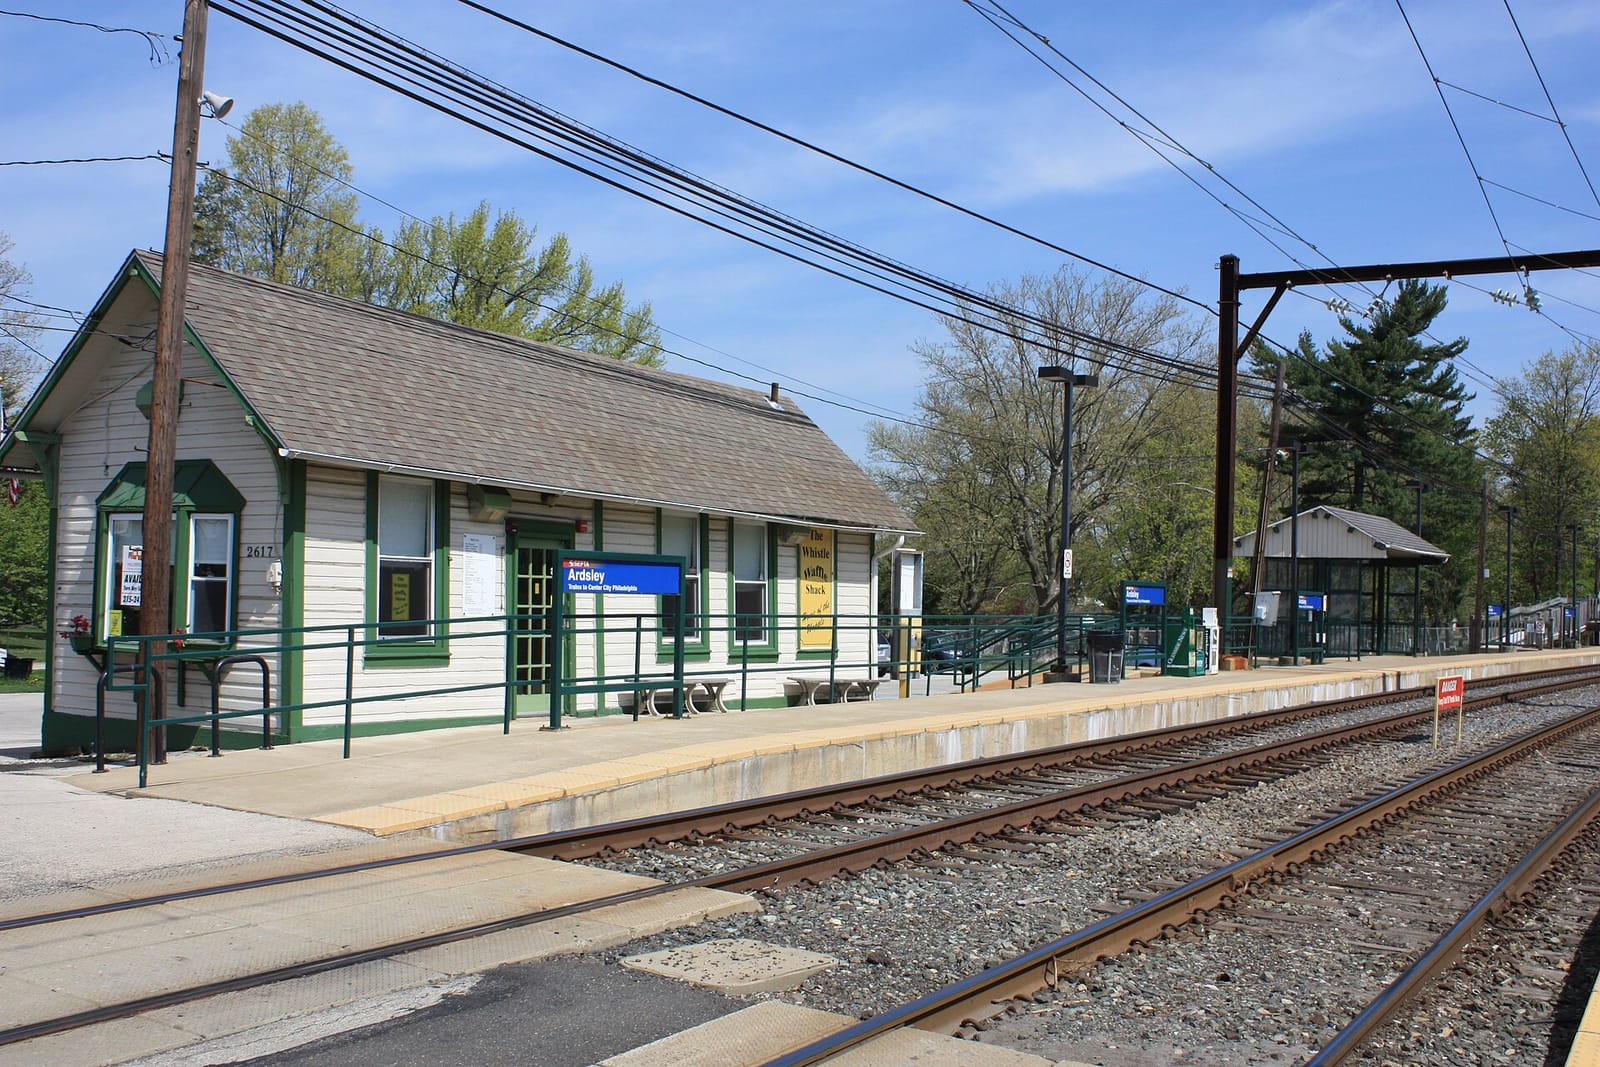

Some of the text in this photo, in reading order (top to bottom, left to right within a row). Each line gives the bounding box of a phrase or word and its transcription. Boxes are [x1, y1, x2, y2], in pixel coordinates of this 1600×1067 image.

[811, 529, 823, 541] The
[247, 546, 273, 558] 2617
[802, 546, 830, 559] Whistle
[568, 568, 605, 584] Ardsley
[804, 565, 828, 582] Waffle
[568, 583, 582, 591] Trains
[588, 584, 603, 592] Center
[805, 584, 826, 595] Shack
